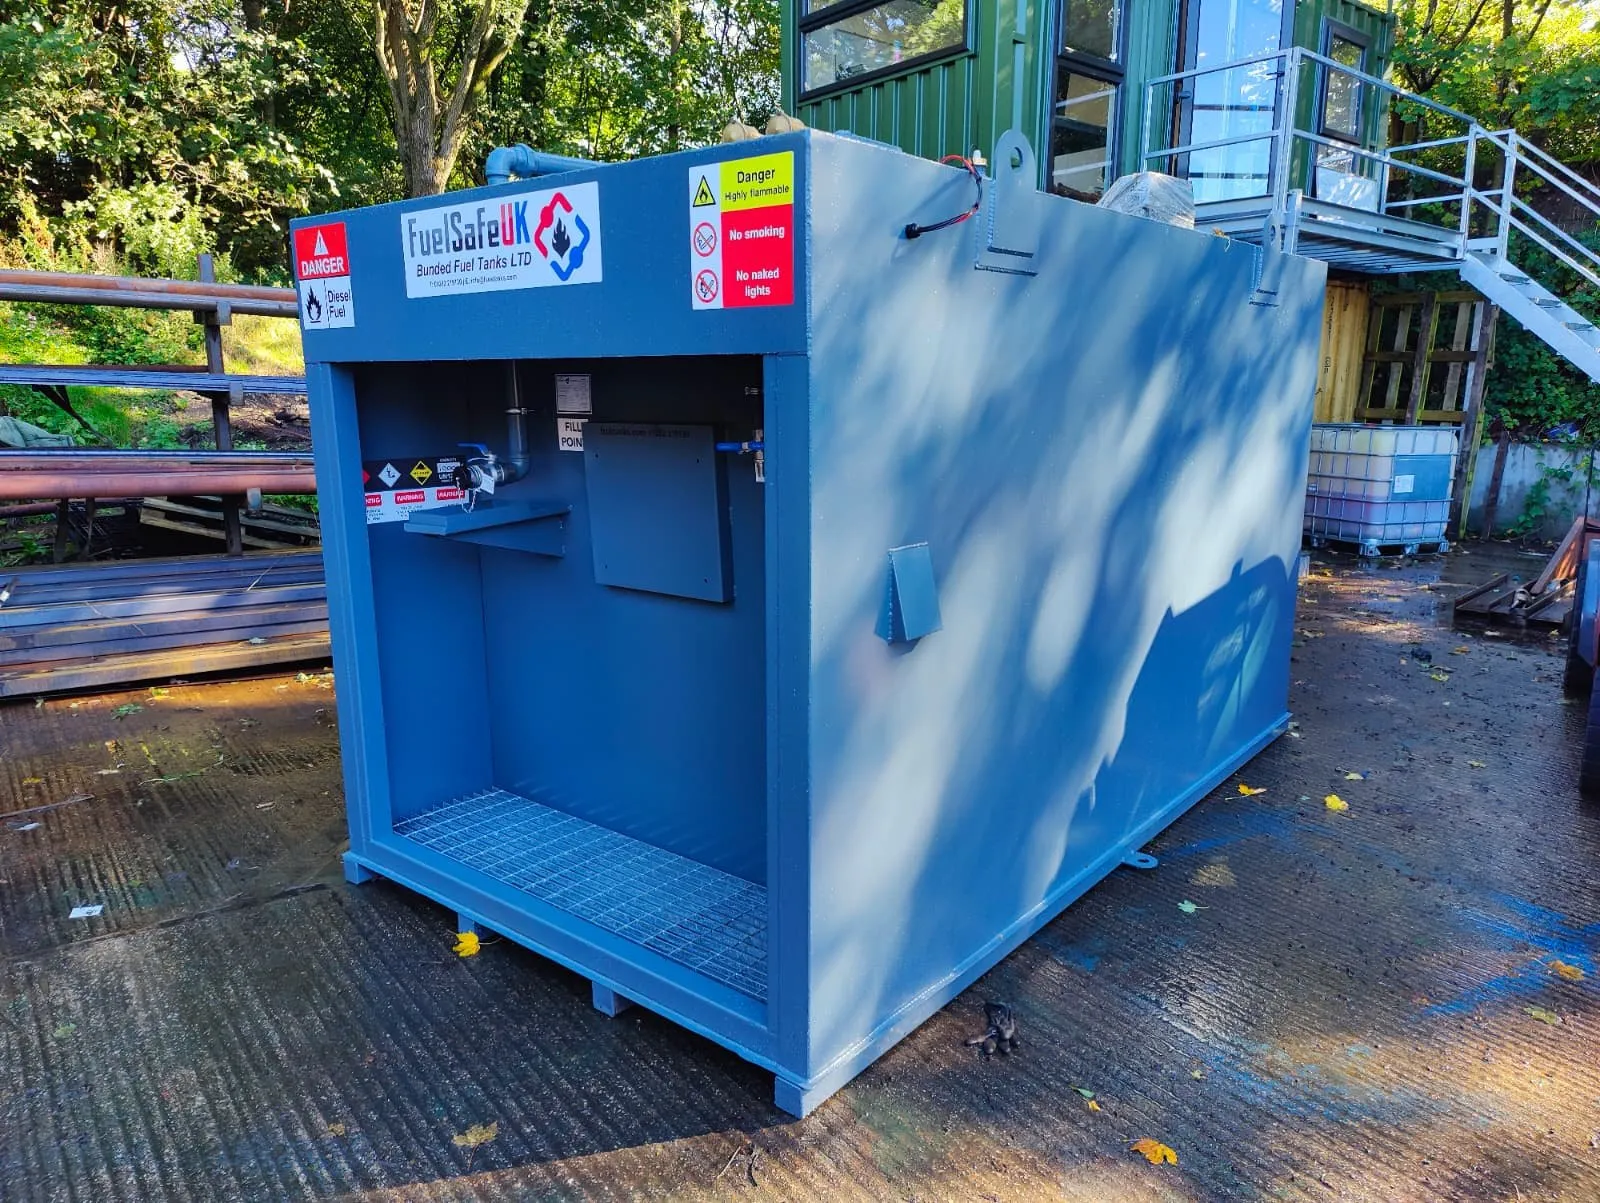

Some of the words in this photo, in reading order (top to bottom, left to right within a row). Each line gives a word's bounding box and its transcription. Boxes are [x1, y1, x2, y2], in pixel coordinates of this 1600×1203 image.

[737, 168, 775, 184] Danger
[725, 191, 747, 202] Highly
[750, 185, 790, 198] flammable
[729, 229, 741, 241] No
[744, 226, 785, 239] smoking
[301, 256, 345, 276] DANGER
[417, 260, 452, 277] Bunded
[454, 257, 474, 273] Fuel
[478, 255, 507, 271] Tanks
[511, 252, 532, 268] LTD
[736, 270, 749, 281] No
[751, 267, 780, 280] naked
[327, 289, 351, 303] Diesel
[745, 285, 771, 298] lights
[329, 305, 346, 318] Fuel
[565, 422, 582, 432] FILL
[562, 437, 583, 447] POIN
